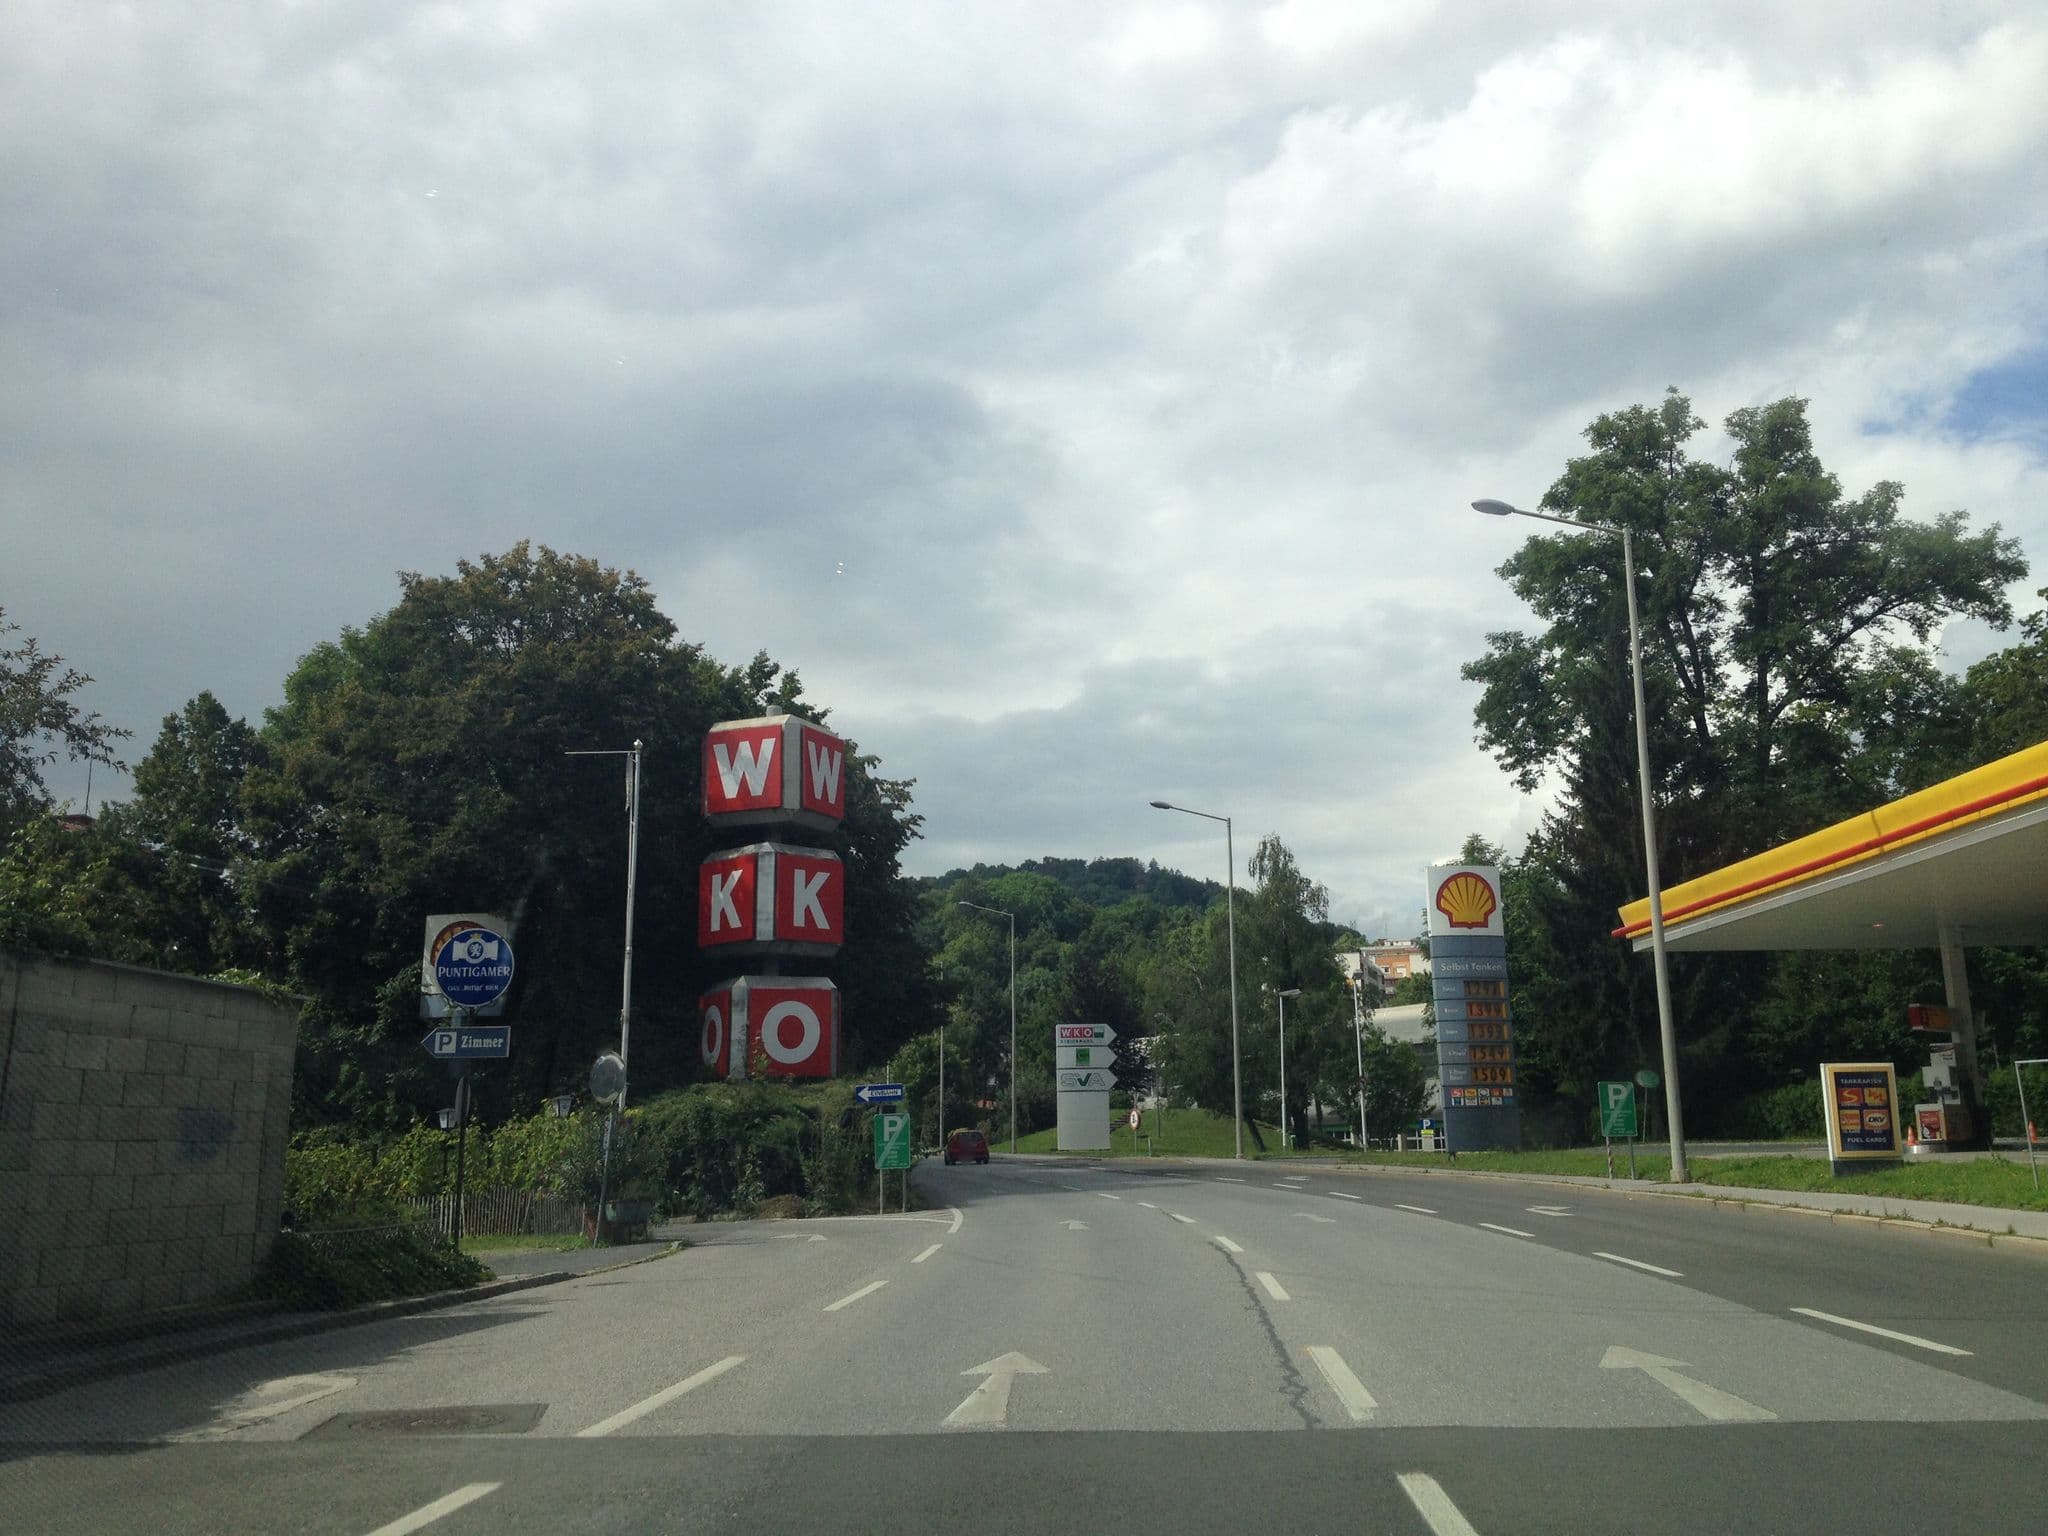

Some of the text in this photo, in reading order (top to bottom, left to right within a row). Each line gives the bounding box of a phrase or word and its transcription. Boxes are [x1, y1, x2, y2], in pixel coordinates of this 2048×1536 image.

[713, 737, 776, 799] W
[807, 740, 842, 804] W
[710, 869, 744, 932] K
[793, 869, 831, 930] K
[438, 966, 511, 978] PUNTIGAMER
[1440, 962, 1503, 971] Selbst Tanken
[439, 1034, 504, 1051] P Zimmer
[761, 1001, 821, 1064] O
[1061, 1028, 1092, 1037] WKO
[1061, 1072, 1105, 1087] SVA
[1607, 1084, 1628, 1109] P
[883, 1116, 903, 1142] P
[1423, 1119, 1431, 1130] P
